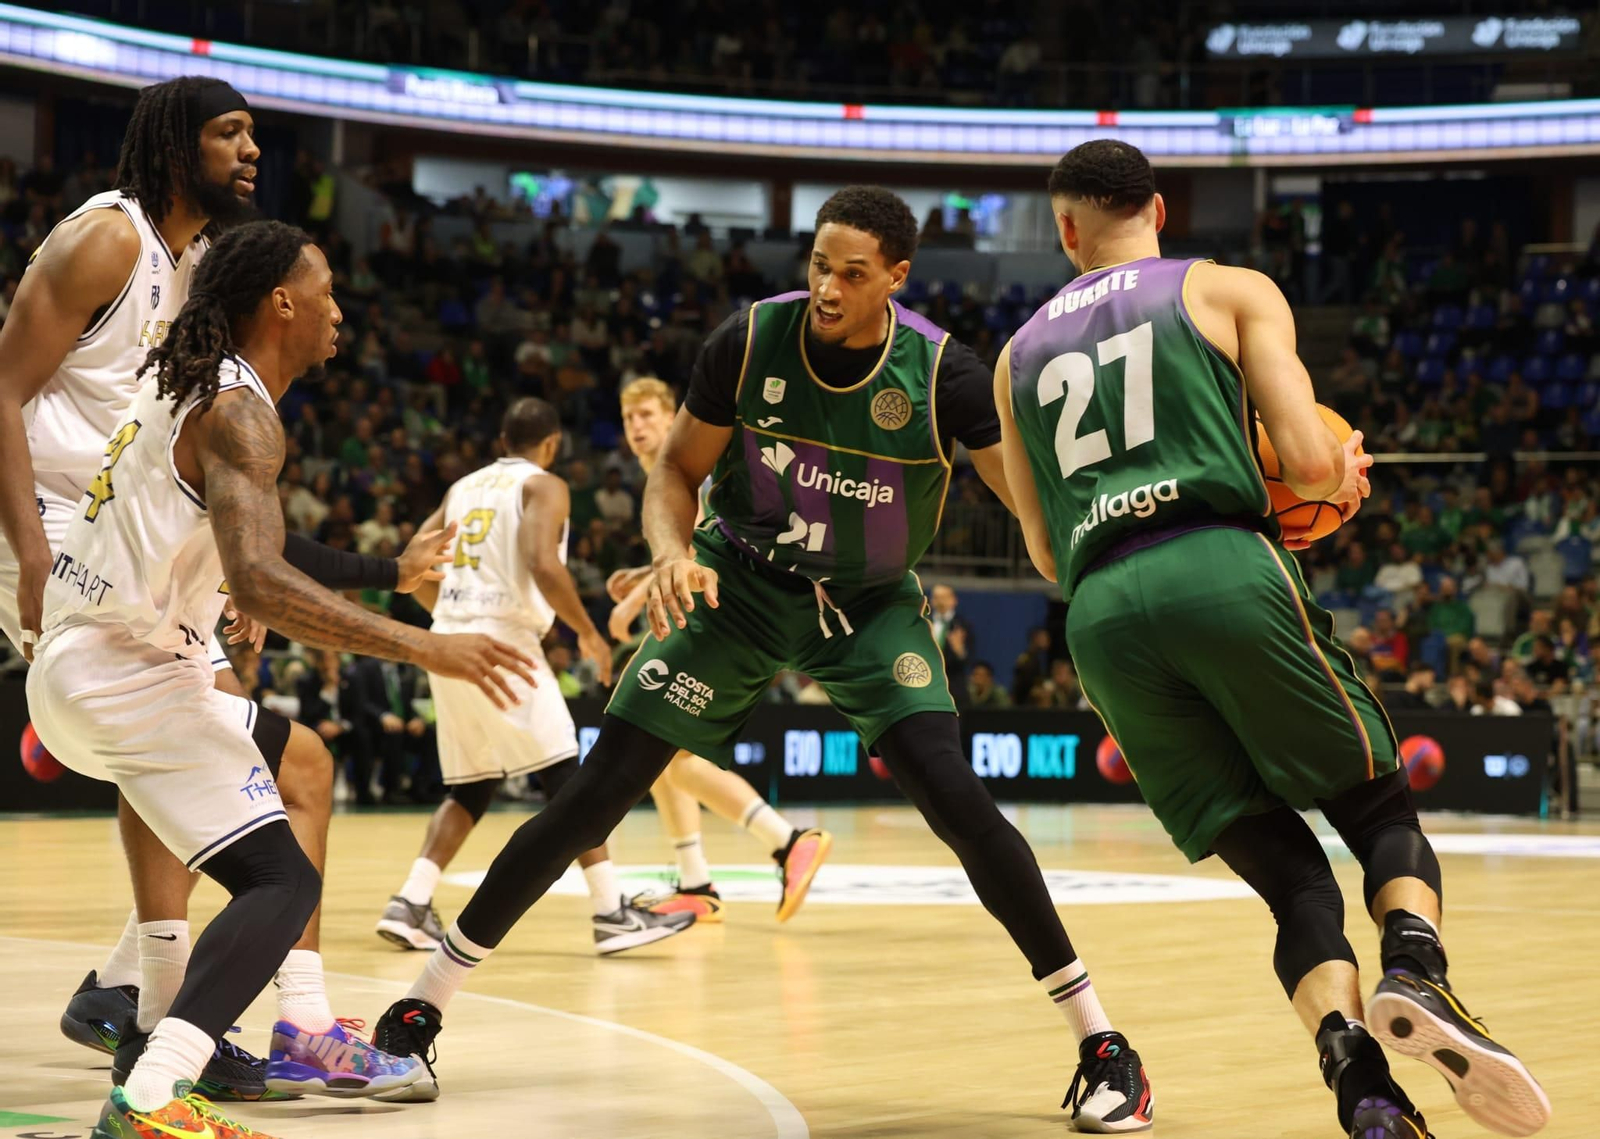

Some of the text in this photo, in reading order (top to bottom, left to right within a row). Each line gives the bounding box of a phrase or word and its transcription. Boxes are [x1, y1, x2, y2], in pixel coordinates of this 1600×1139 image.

[1048, 269, 1140, 321] DUARTE
[1037, 321, 1155, 479] 27
[797, 462, 894, 508] Unicaja
[1070, 479, 1180, 550] málaga
[453, 508, 496, 571] 2
[663, 692, 702, 717] MÁLAGA
[669, 682, 708, 709] DEL SOL
[676, 672, 714, 701] COSTA
[784, 729, 822, 776] EVO
[823, 730, 860, 776] NXT
[972, 732, 1081, 779] EVO NXT
